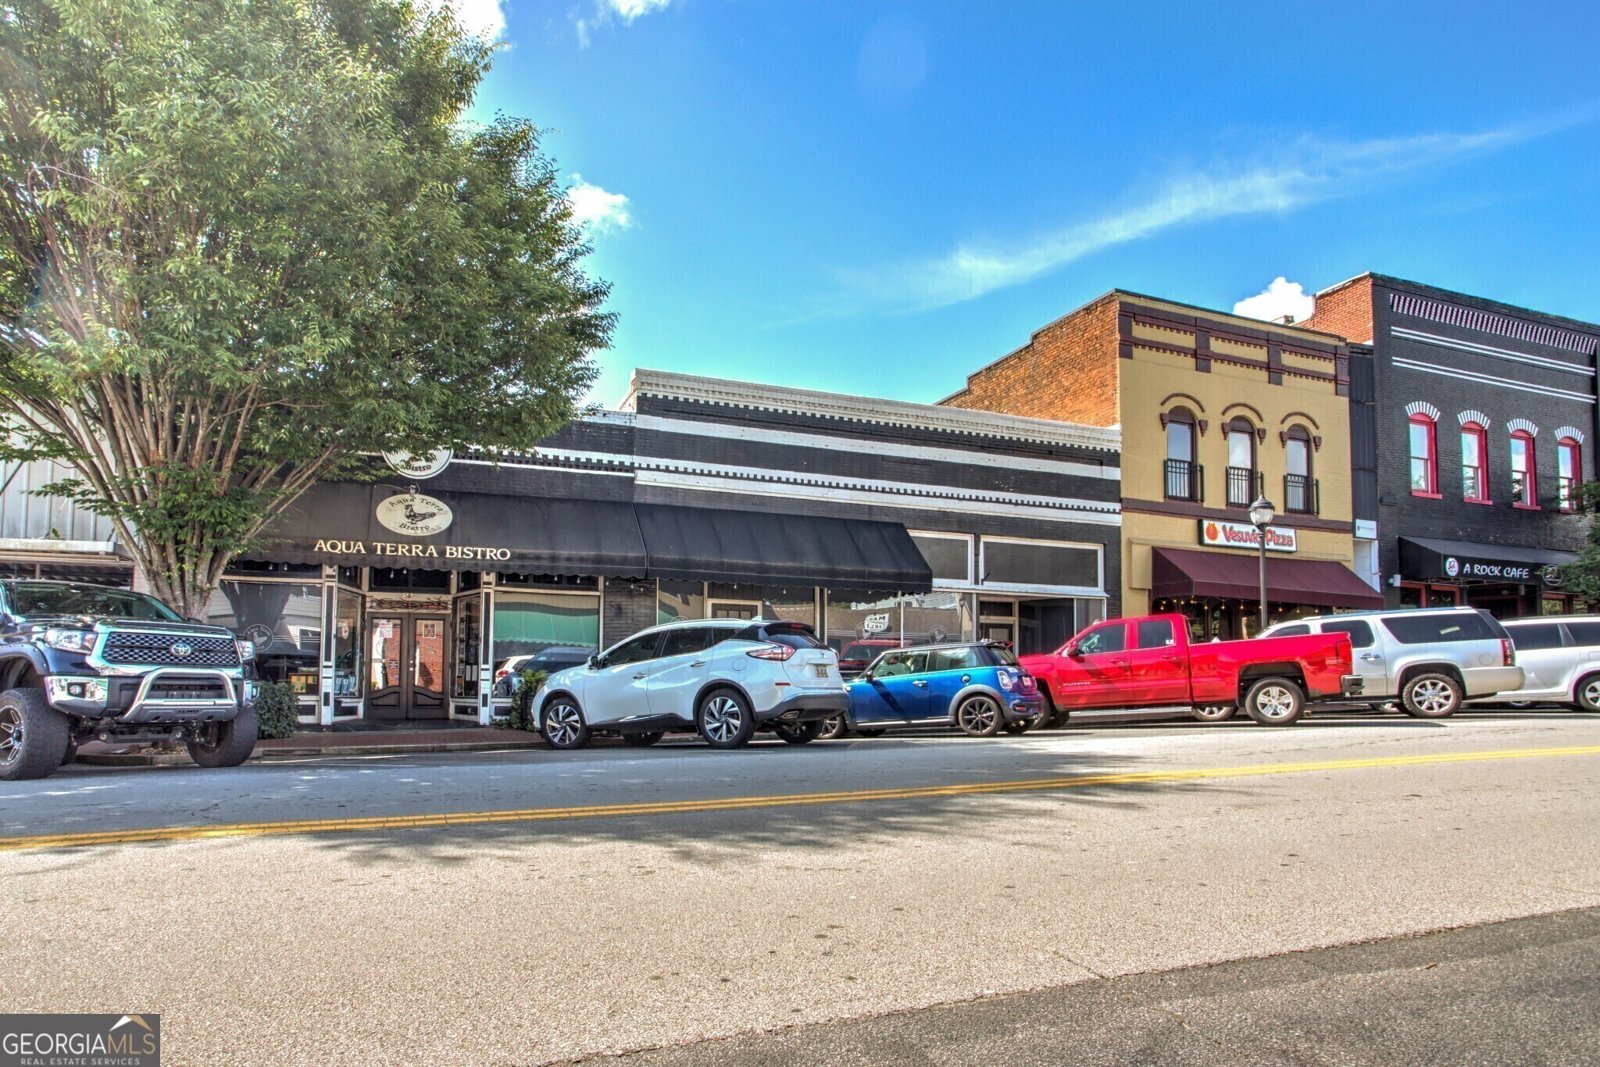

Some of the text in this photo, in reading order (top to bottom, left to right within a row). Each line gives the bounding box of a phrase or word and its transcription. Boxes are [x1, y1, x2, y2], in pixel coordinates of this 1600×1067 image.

[405, 463, 432, 472] Bistro
[388, 497, 444, 512] Aqua Terra
[399, 522, 430, 531] Bistro
[1264, 528, 1294, 547] Pizza
[314, 539, 511, 560] AQUA TERRA BISTRO
[1463, 563, 1529, 579] A ROCK CAFE
